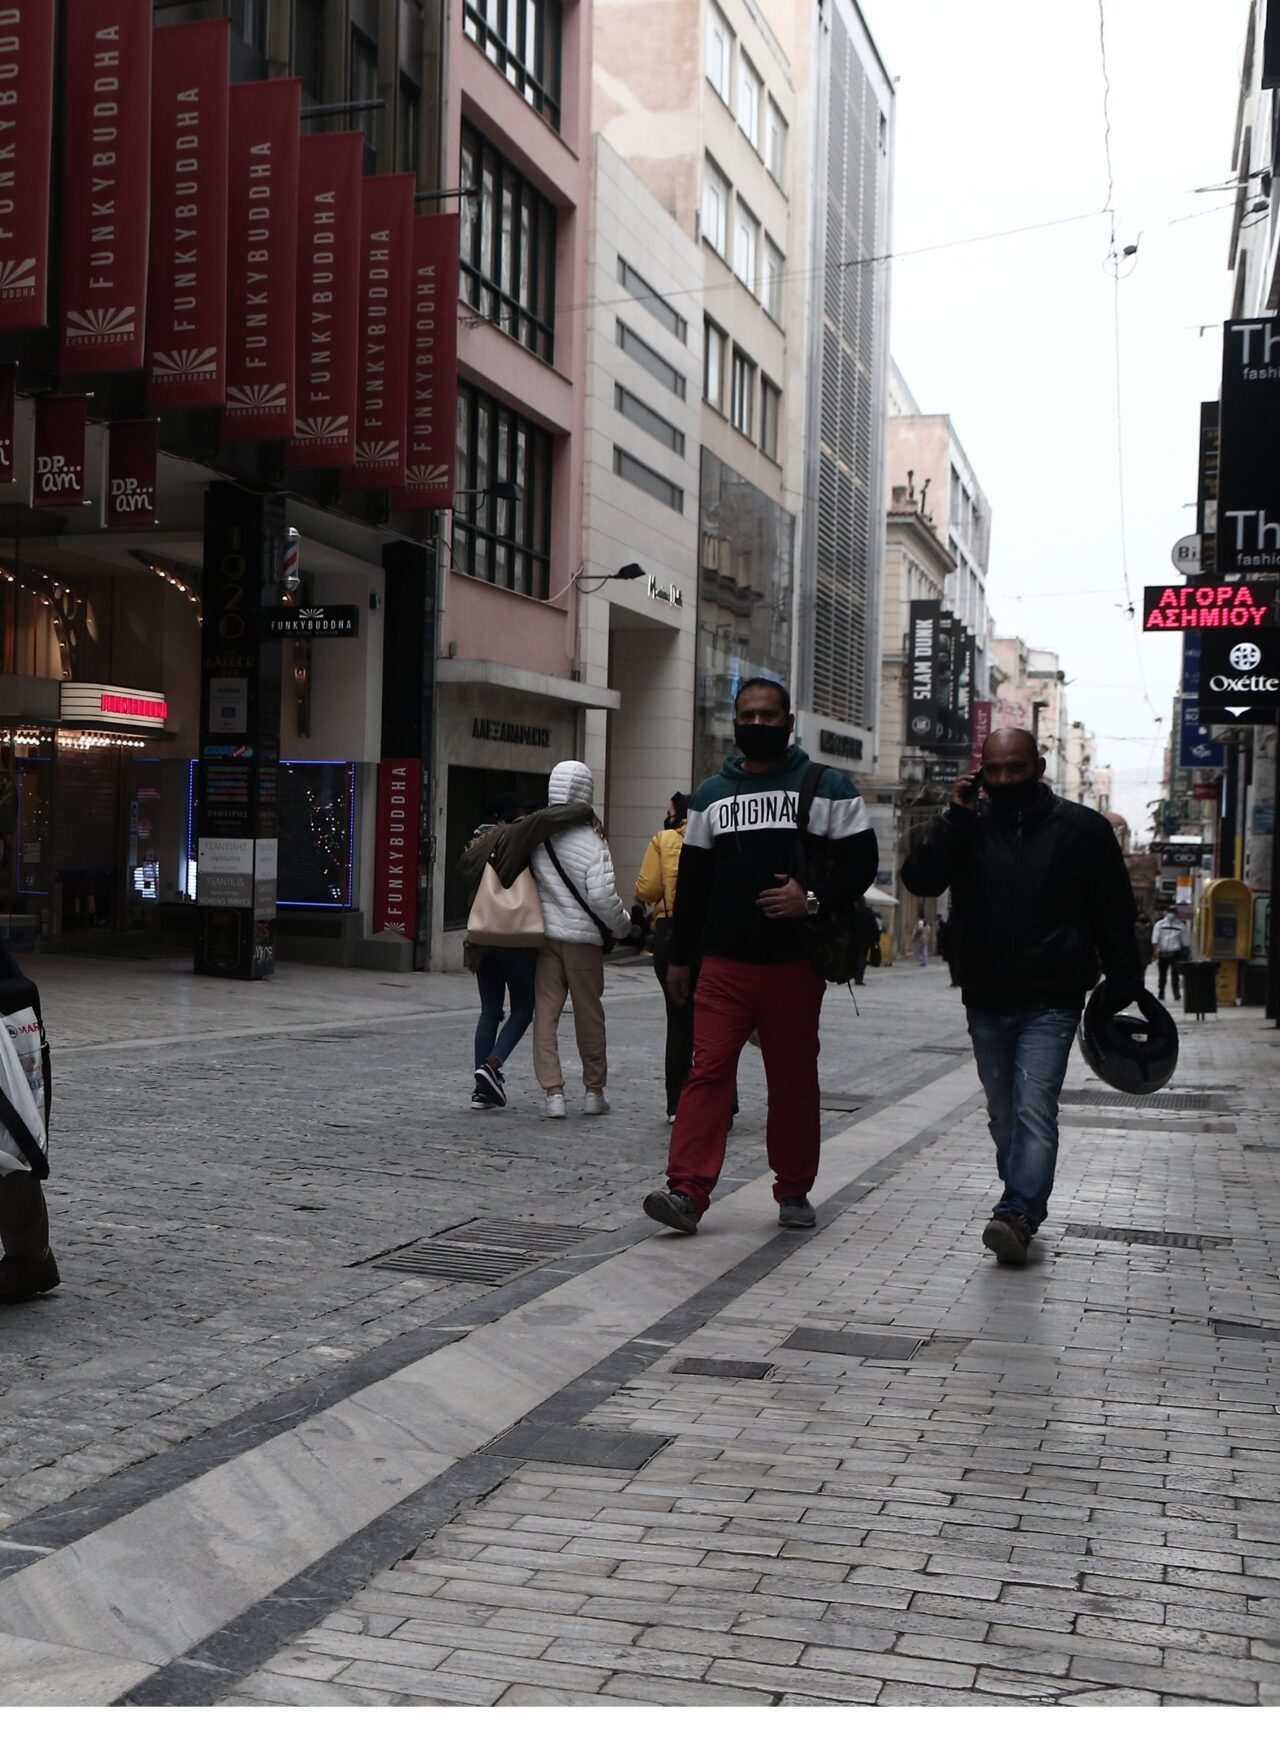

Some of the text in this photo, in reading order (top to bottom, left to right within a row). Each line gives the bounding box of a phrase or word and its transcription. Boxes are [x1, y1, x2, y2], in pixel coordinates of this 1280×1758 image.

[90, 24, 120, 288] FUNKYBUDDHA
[174, 87, 199, 331] FUNKYBUDDHA
[246, 142, 271, 368] FUNKYBUDDHA
[311, 191, 335, 401] FUNKYBUDDHA
[364, 229, 390, 427] FUNKYBUDDHA
[414, 265, 436, 451] FUNKYBUDDHA
[41, 473, 81, 492] am
[115, 494, 153, 512] am
[271, 619, 352, 630] FUNKYBUDDHA
[1145, 606, 1269, 628] ΑΣΗΜΙΟΥ
[1158, 586, 1254, 607] ΑΓΟΡΑ
[912, 618, 934, 700] SLAM DUNK
[1209, 674, 1280, 692] Oxétte
[387, 767, 407, 915] FUNKYBUDDHA
[18, 1021, 41, 1034] MAR
